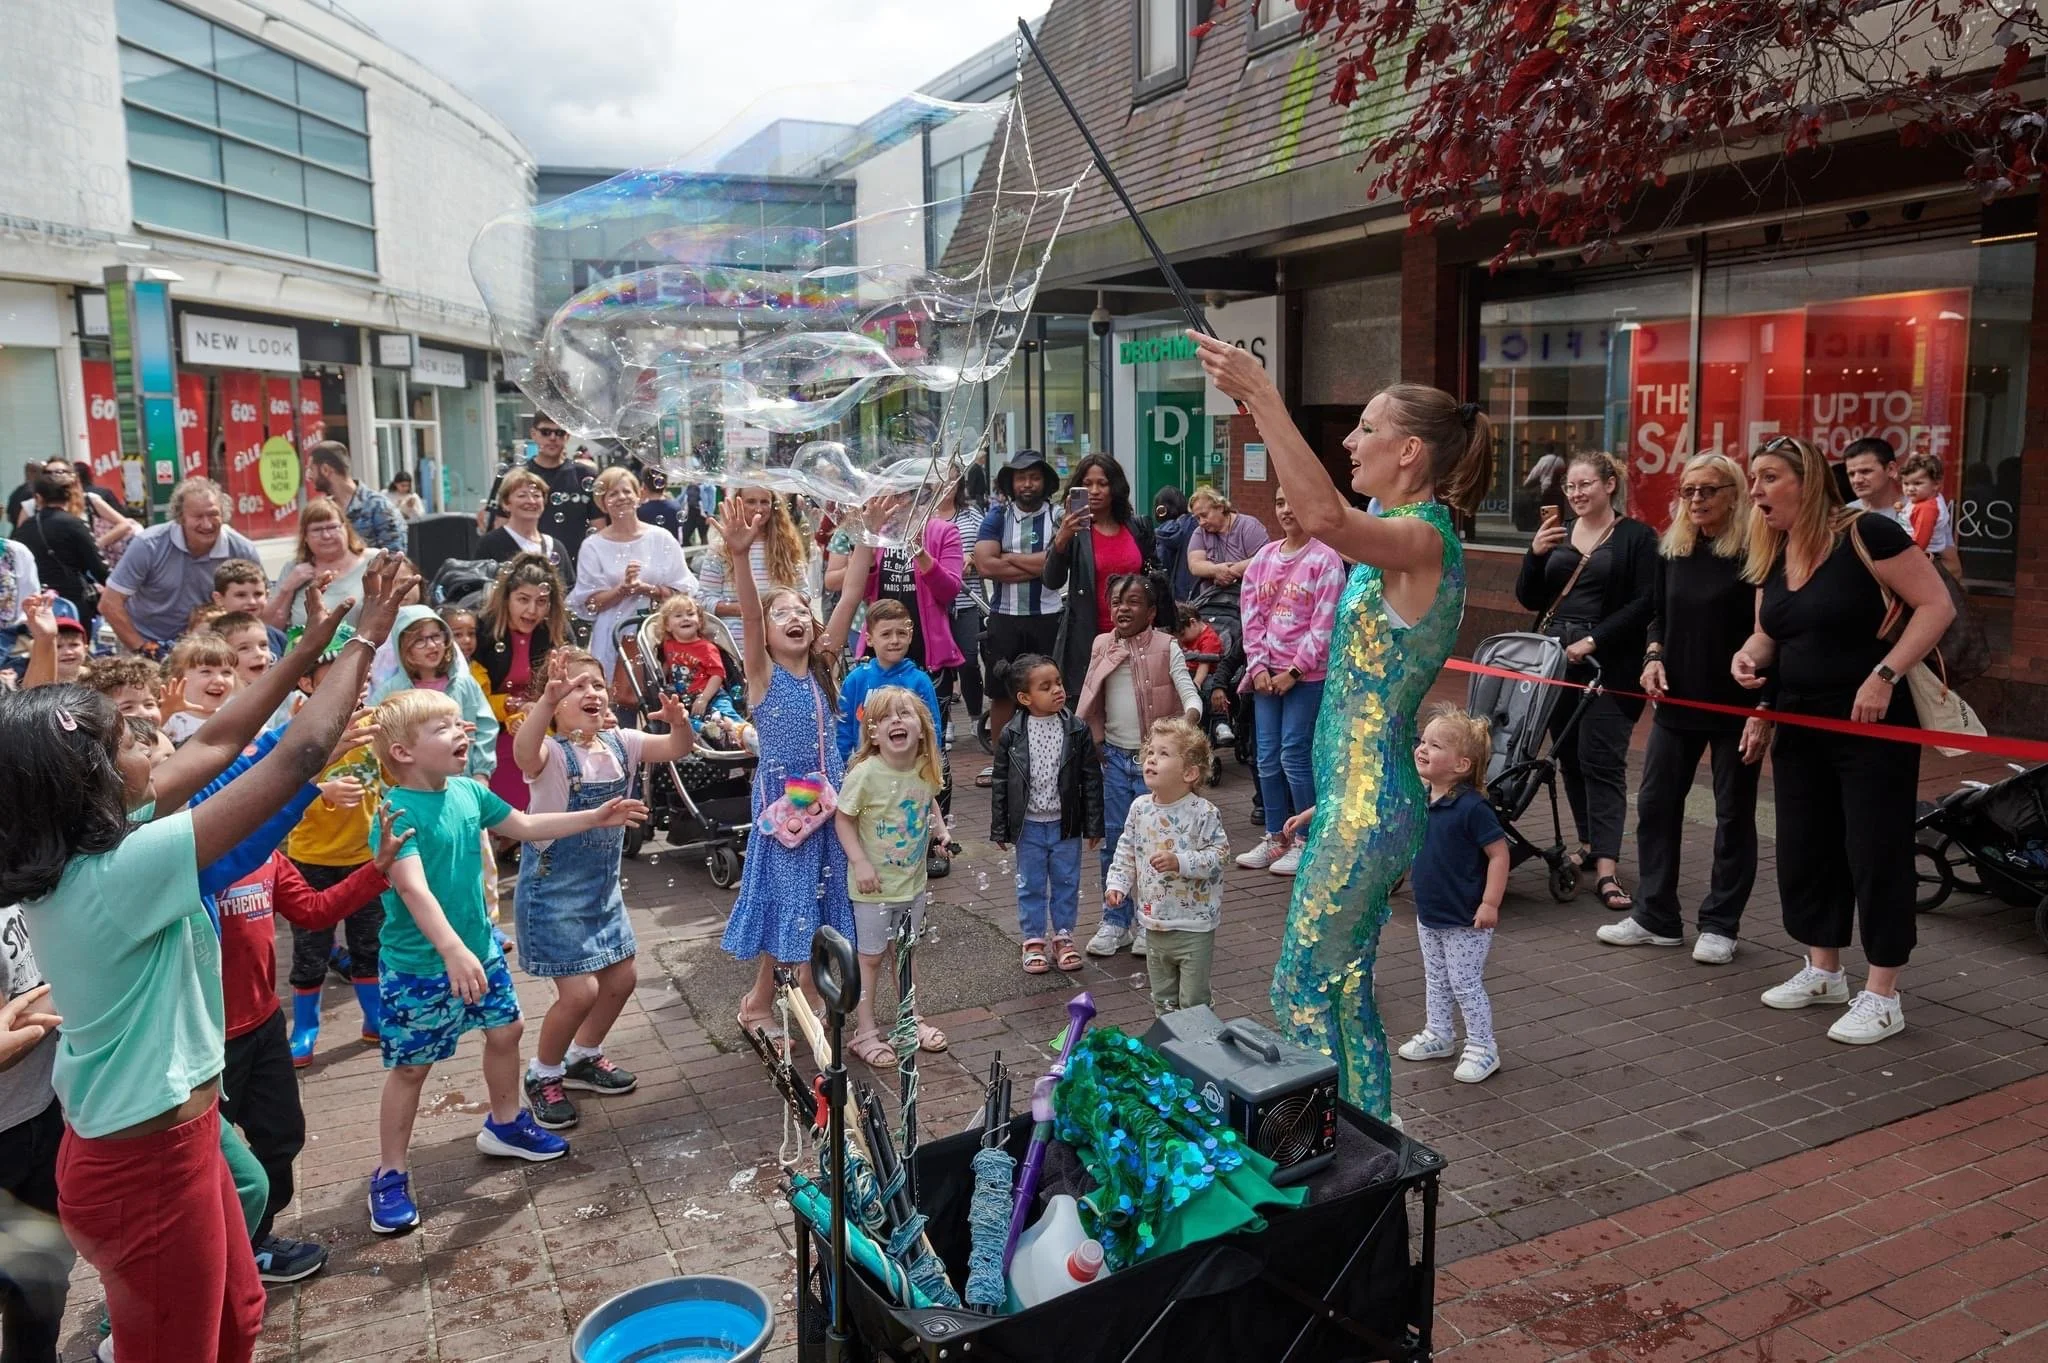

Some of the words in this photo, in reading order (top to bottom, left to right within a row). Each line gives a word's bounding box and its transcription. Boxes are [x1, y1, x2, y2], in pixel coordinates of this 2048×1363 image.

[196, 330, 239, 350] NEW
[248, 338, 293, 357] LOOK
[1637, 384, 1690, 415] THE
[1813, 392, 1859, 424] UP
[1864, 390, 1913, 423] TO
[1813, 426, 1879, 458] 50%
[1880, 425, 1952, 458] OFF
[94, 450, 121, 477] SAL
[270, 459, 287, 468] NEW
[272, 470, 288, 480] SALE
